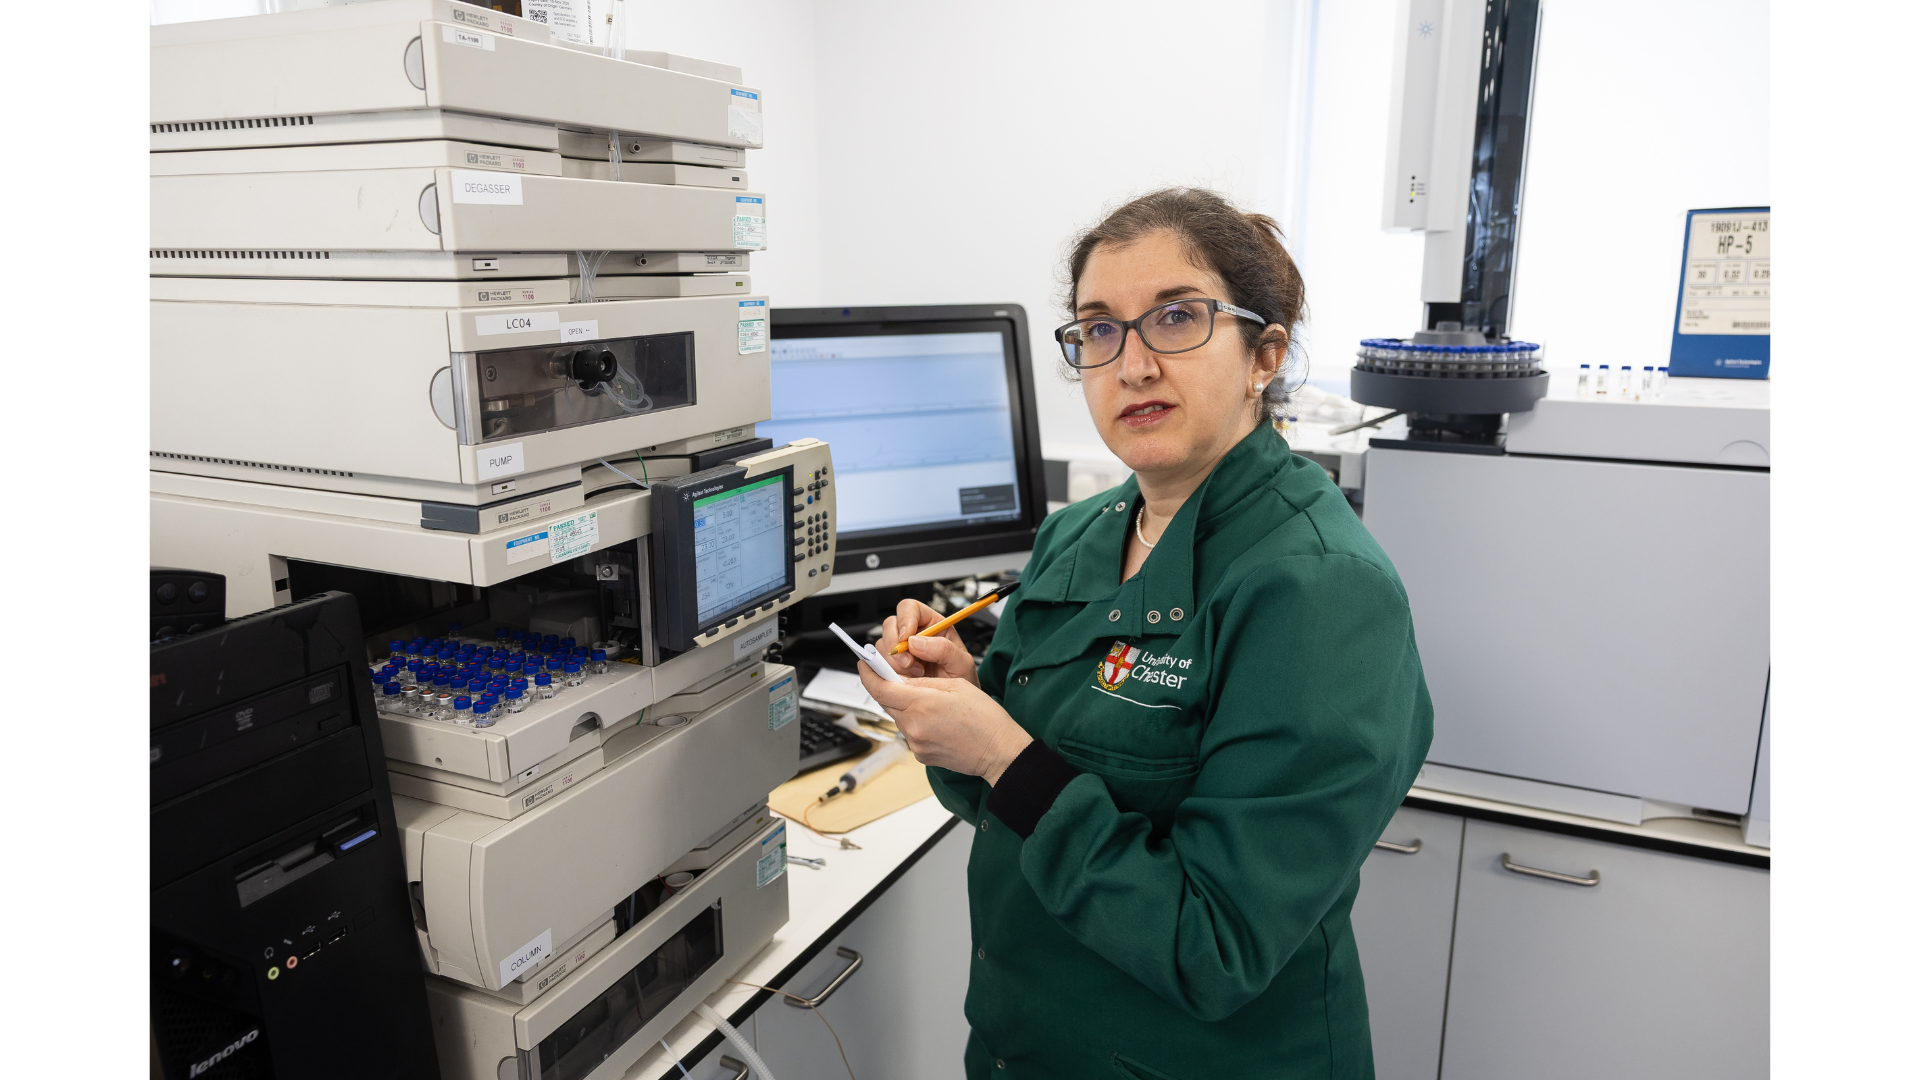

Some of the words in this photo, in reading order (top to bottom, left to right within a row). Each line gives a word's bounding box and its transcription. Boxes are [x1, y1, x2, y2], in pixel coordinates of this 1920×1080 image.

[466, 12, 489, 22] HEWLETT
[466, 18, 490, 28] PACKARD
[500, 25, 513, 34] 1100
[458, 34, 479, 44] TA-1100
[479, 159, 501, 167] PACKARD
[464, 183, 511, 194] DEGASSER
[1717, 235, 1753, 254] HP-5
[506, 318, 532, 329] LC04
[489, 455, 513, 468] PUMP
[691, 490, 704, 498] Agilent
[703, 484, 724, 494] Technologies
[509, 507, 529, 516] HEWLETT
[540, 505, 551, 514] 1100
[509, 512, 530, 521] PACKARD
[553, 519, 575, 532] PASSED
[740, 628, 773, 650] AUTOSAMPLER
[1178, 659, 1192, 669] of
[1131, 664, 1188, 689] Chester
[510, 944, 542, 972] COLUMN
[190, 1029, 259, 1080] lenovo
